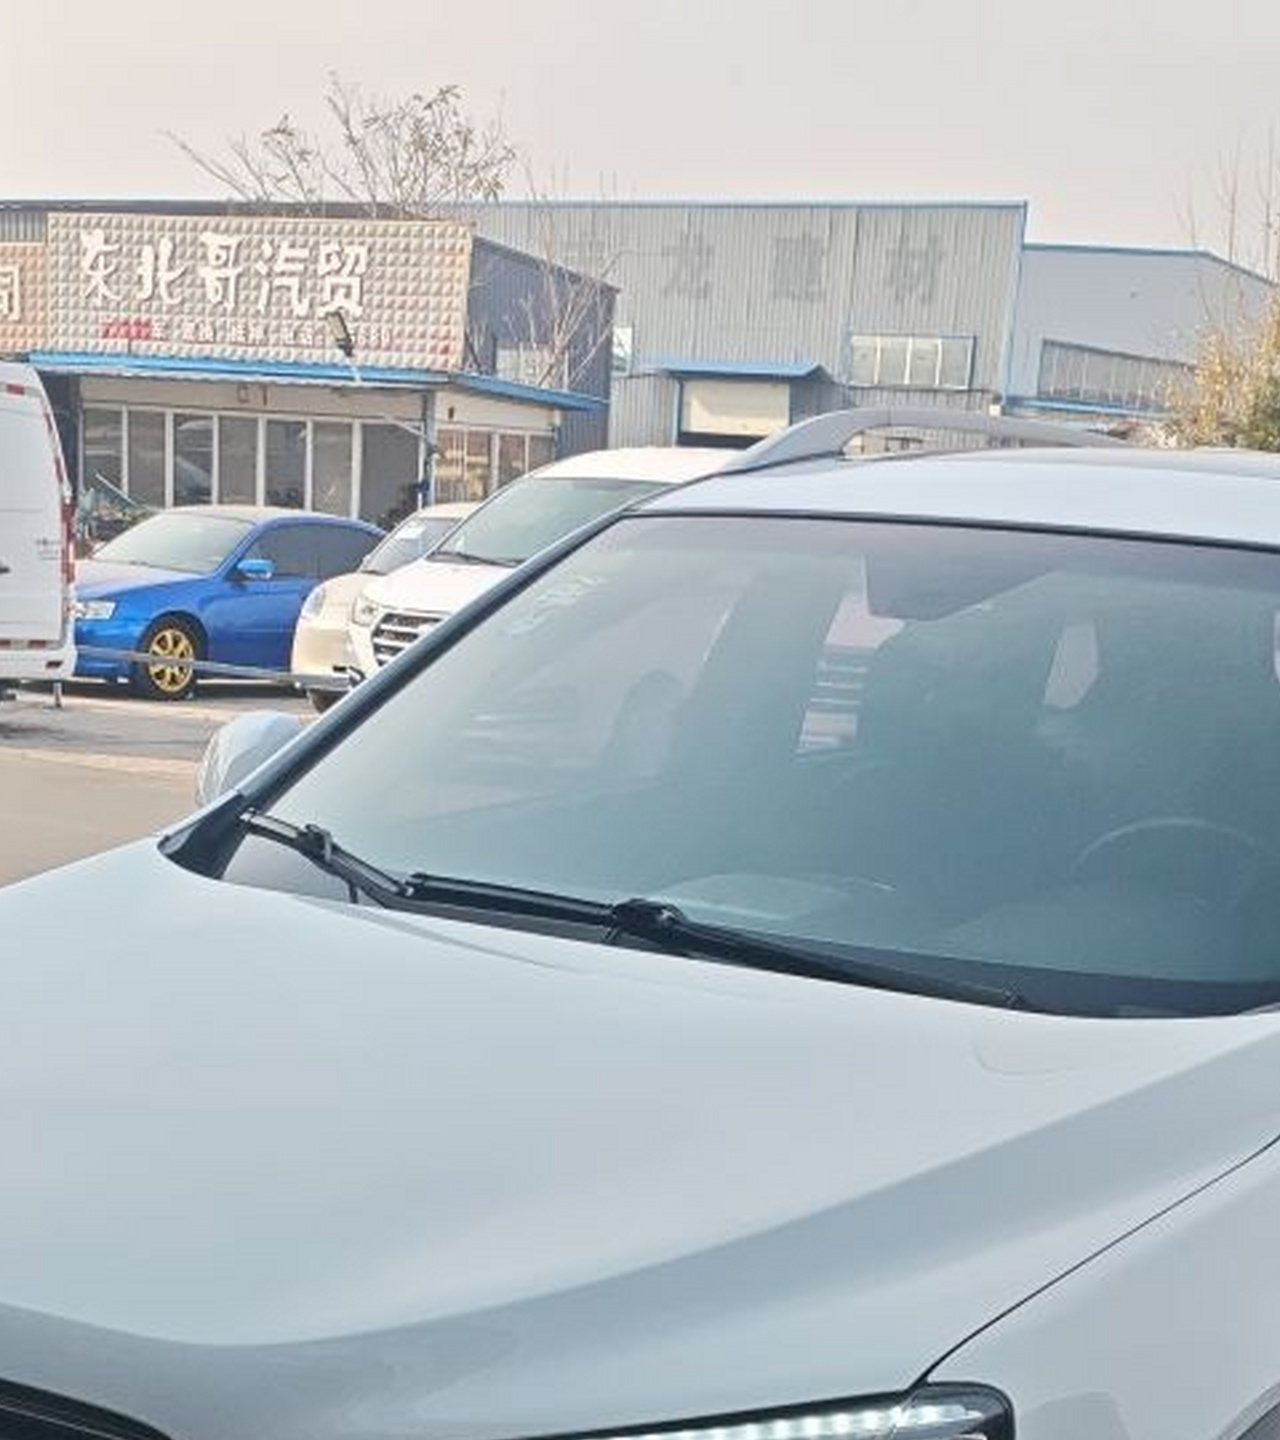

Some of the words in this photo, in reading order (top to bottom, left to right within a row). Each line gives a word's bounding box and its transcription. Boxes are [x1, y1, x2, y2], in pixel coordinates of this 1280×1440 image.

[80, 229, 368, 318] 东北哥汽贸
